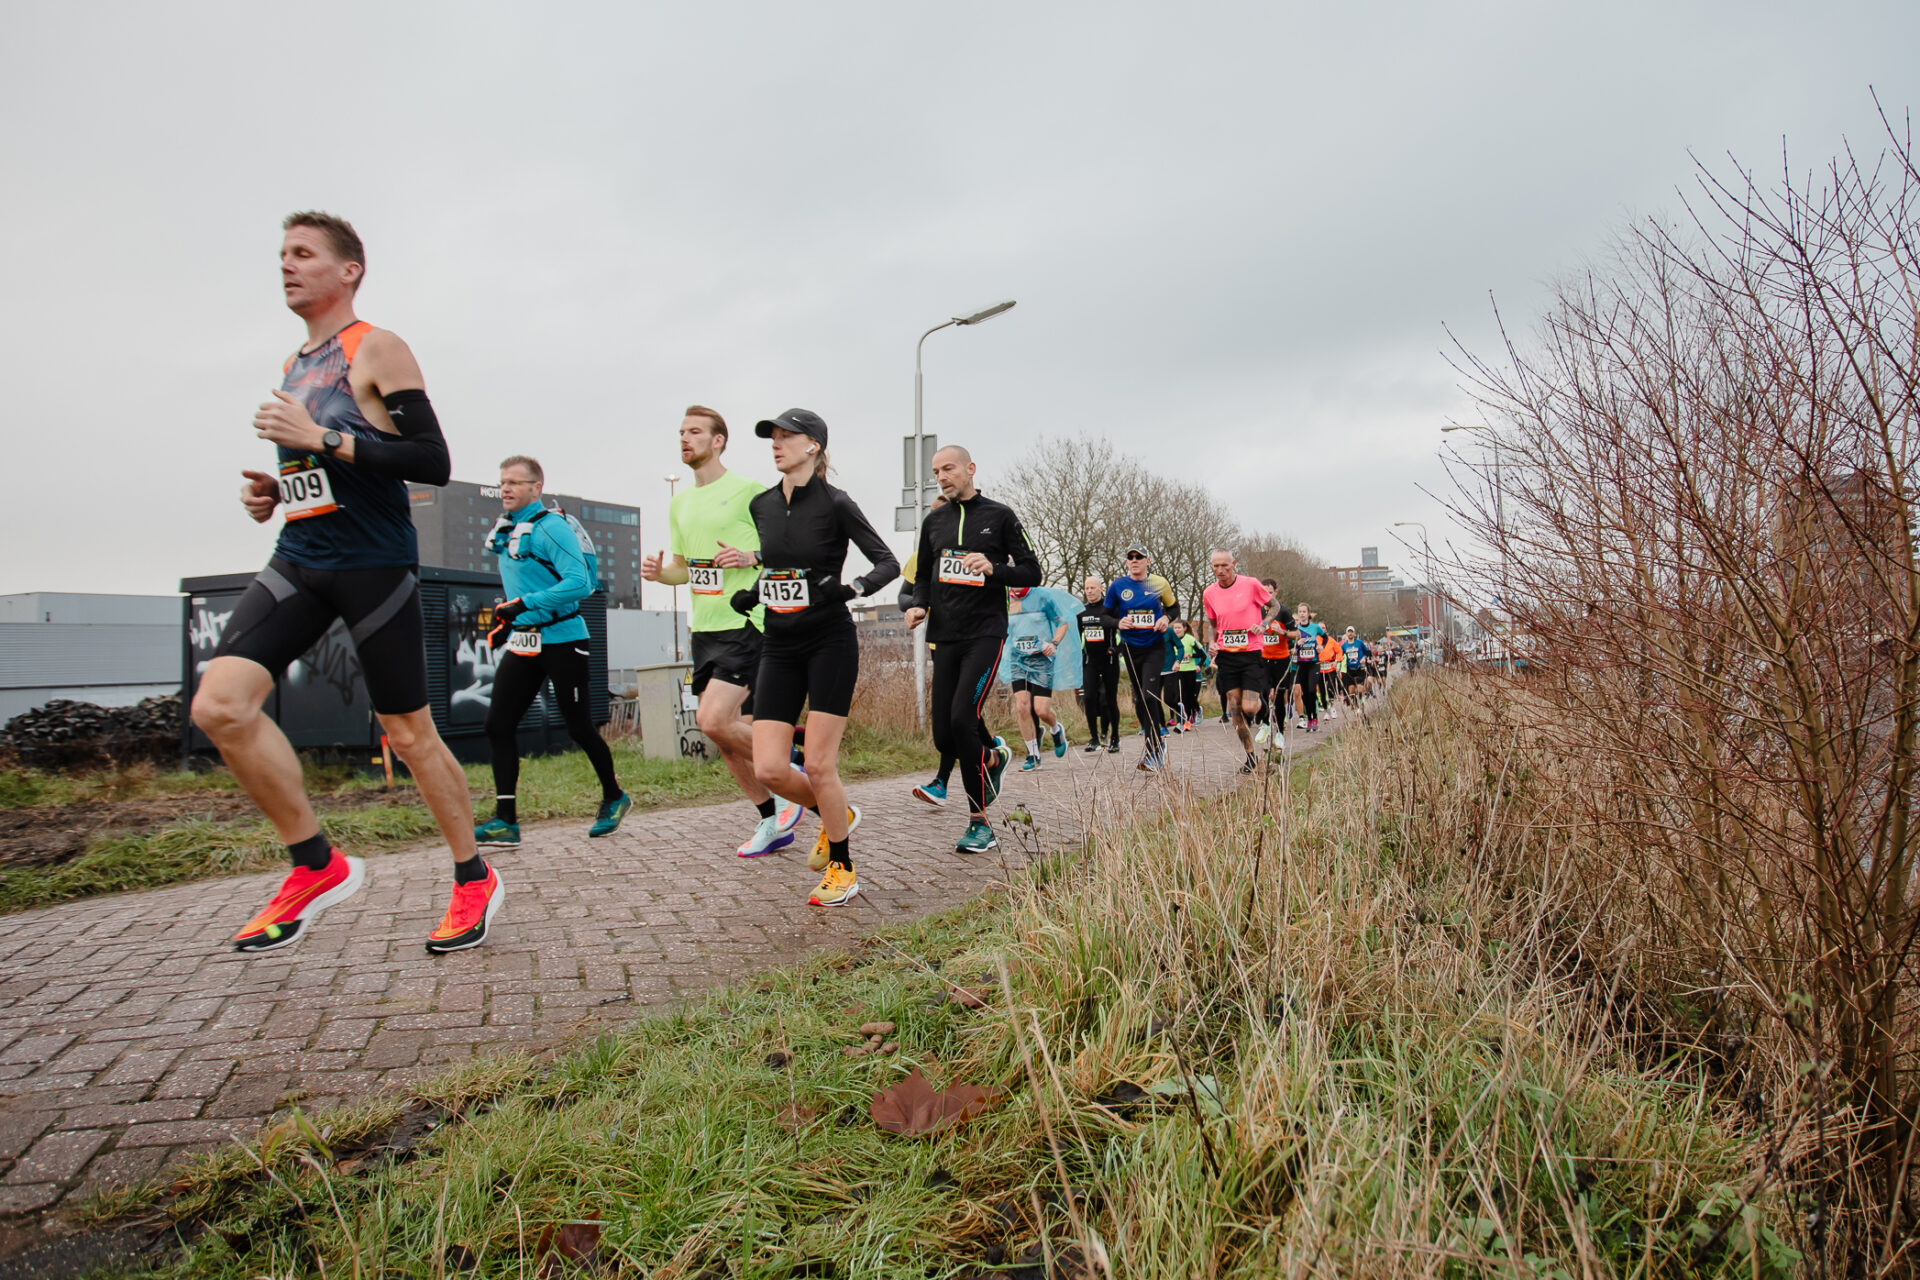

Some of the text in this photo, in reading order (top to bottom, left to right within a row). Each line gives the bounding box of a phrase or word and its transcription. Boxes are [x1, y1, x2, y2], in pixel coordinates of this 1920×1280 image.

[480, 486, 502, 498] HOT
[763, 582, 803, 601] 4152
[1224, 634, 1246, 644] 2342
[1015, 641, 1038, 650] 4132
